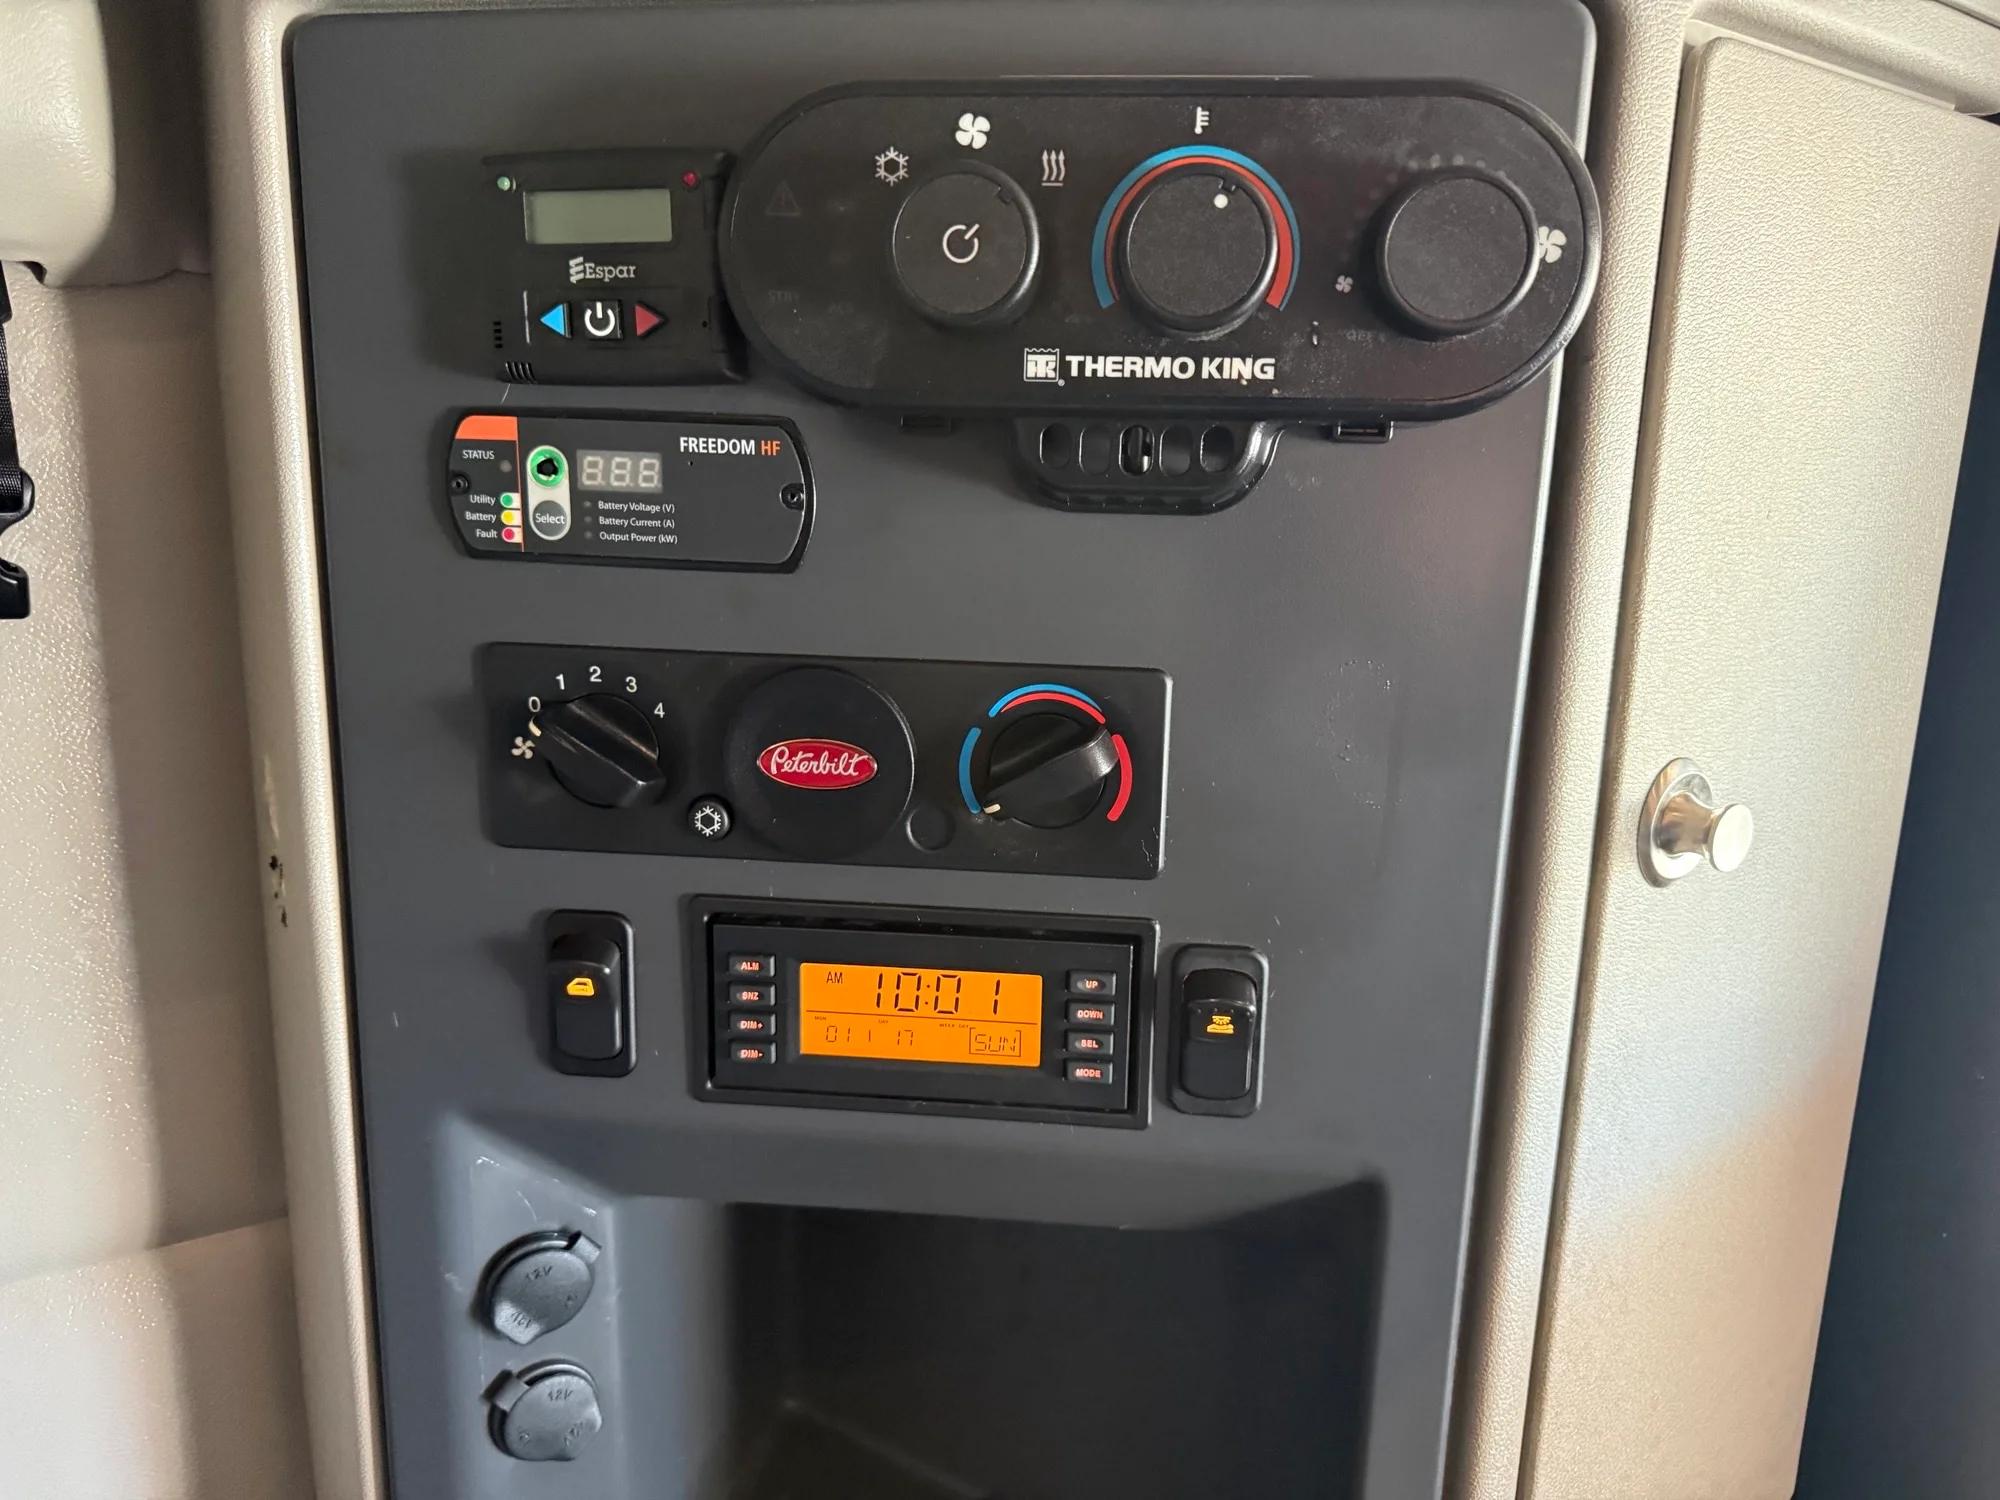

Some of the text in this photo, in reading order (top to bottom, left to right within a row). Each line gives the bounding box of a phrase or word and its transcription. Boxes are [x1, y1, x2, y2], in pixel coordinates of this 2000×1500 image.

[584, 262, 637, 283] Espar
[1065, 355, 1276, 380] THERMO KING
[679, 436, 782, 457] FREEDOM HF
[462, 450, 495, 460] STATUS
[469, 494, 497, 506] Utility
[598, 501, 675, 514] Battery Voltage (V)
[465, 511, 497, 522] Battery
[535, 513, 565, 525] Select
[599, 516, 675, 530] Battery Current (A)
[476, 529, 498, 539] Fault
[599, 532, 678, 545] Output Power (kW)
[588, 666, 603, 683] 2
[556, 674, 566, 690] 1
[625, 676, 638, 693] 3
[528, 697, 542, 713] 0
[653, 702, 666, 718] 4
[770, 745, 868, 777] Peterbilt
[740, 962, 760, 971] ALM
[1085, 980, 1099, 990] UP
[741, 991, 759, 1001] SNZ
[826, 971, 1001, 1016] AM 10:01
[1077, 1010, 1104, 1020] DOWN
[974, 1033, 1017, 1053] SUN
[1081, 1039, 1098, 1049] SEL
[1075, 1068, 1102, 1078] MODE
[547, 1388, 574, 1402] 12V
